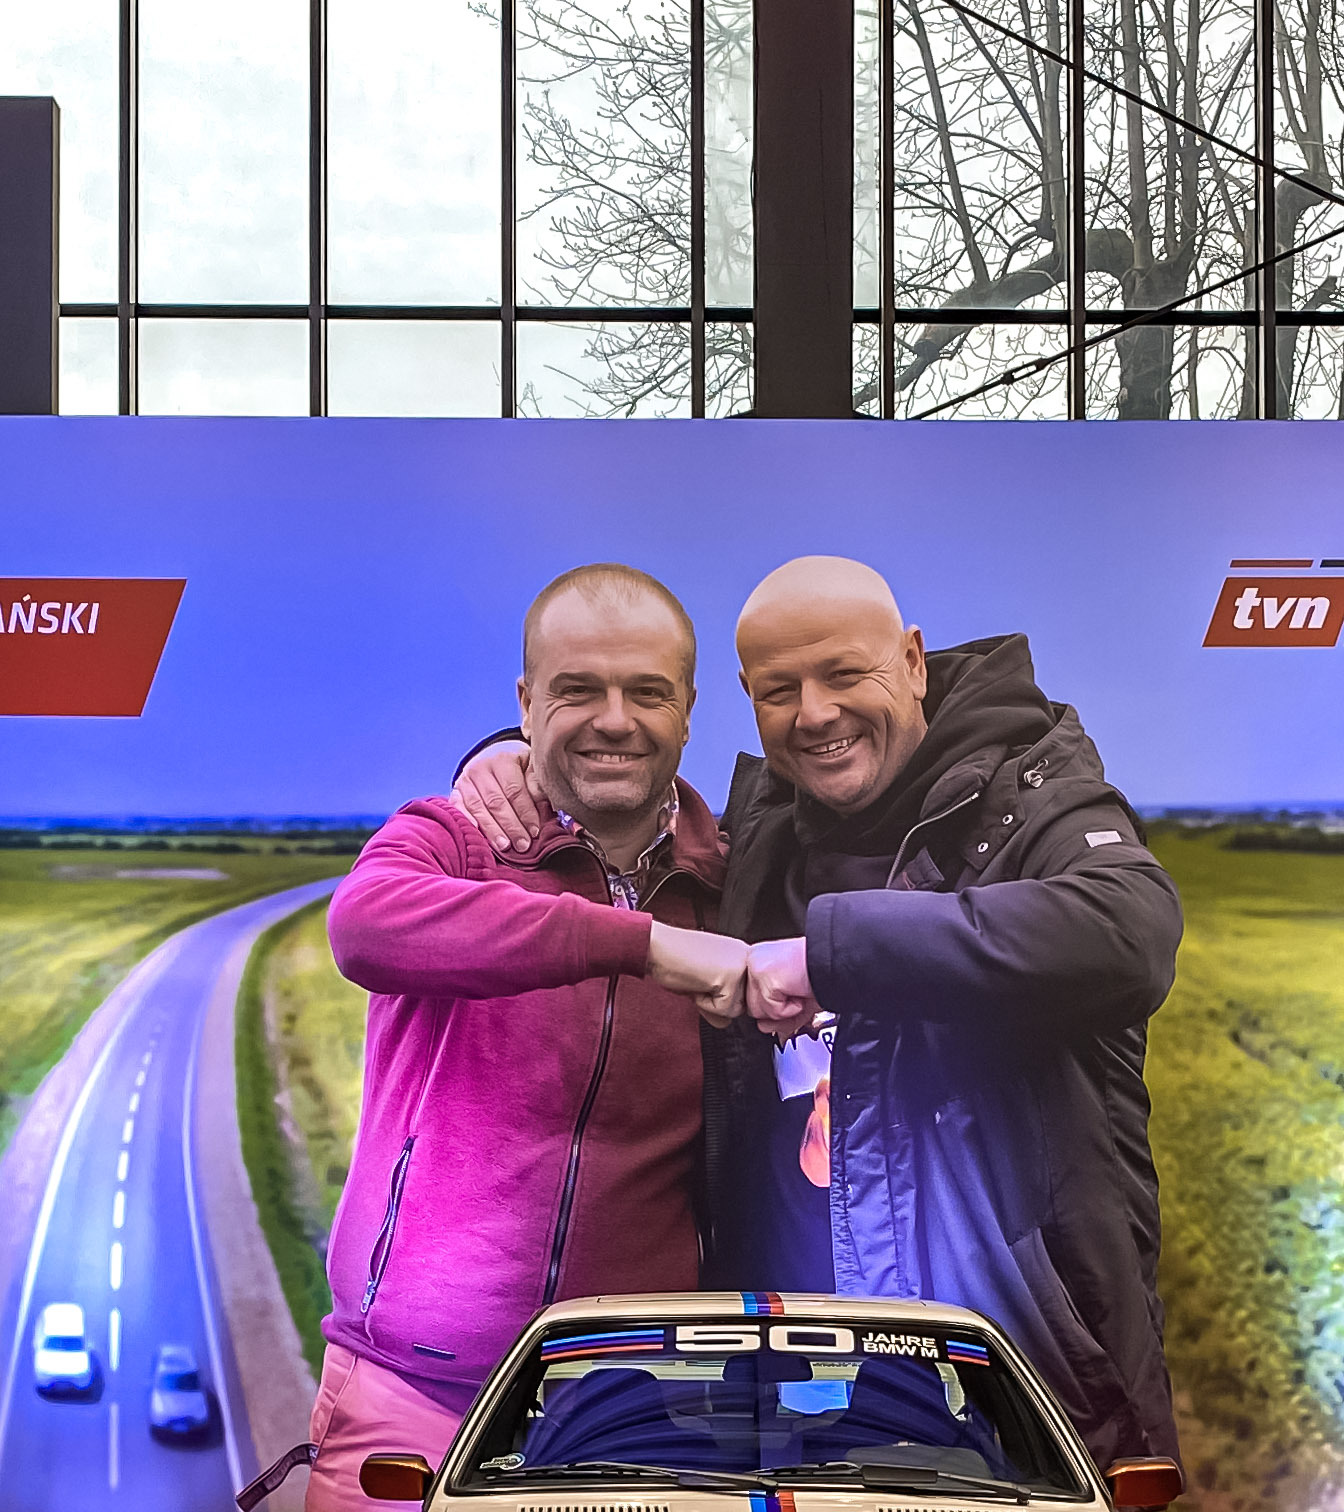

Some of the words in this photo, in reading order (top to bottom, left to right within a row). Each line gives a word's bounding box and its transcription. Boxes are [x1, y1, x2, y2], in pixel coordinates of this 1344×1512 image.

[1232, 587, 1330, 629] tvn
[675, 1325, 855, 1353] 50
[862, 1332, 937, 1347] JAHRE
[863, 1343, 921, 1356] BMW
[921, 1347, 940, 1358] M
